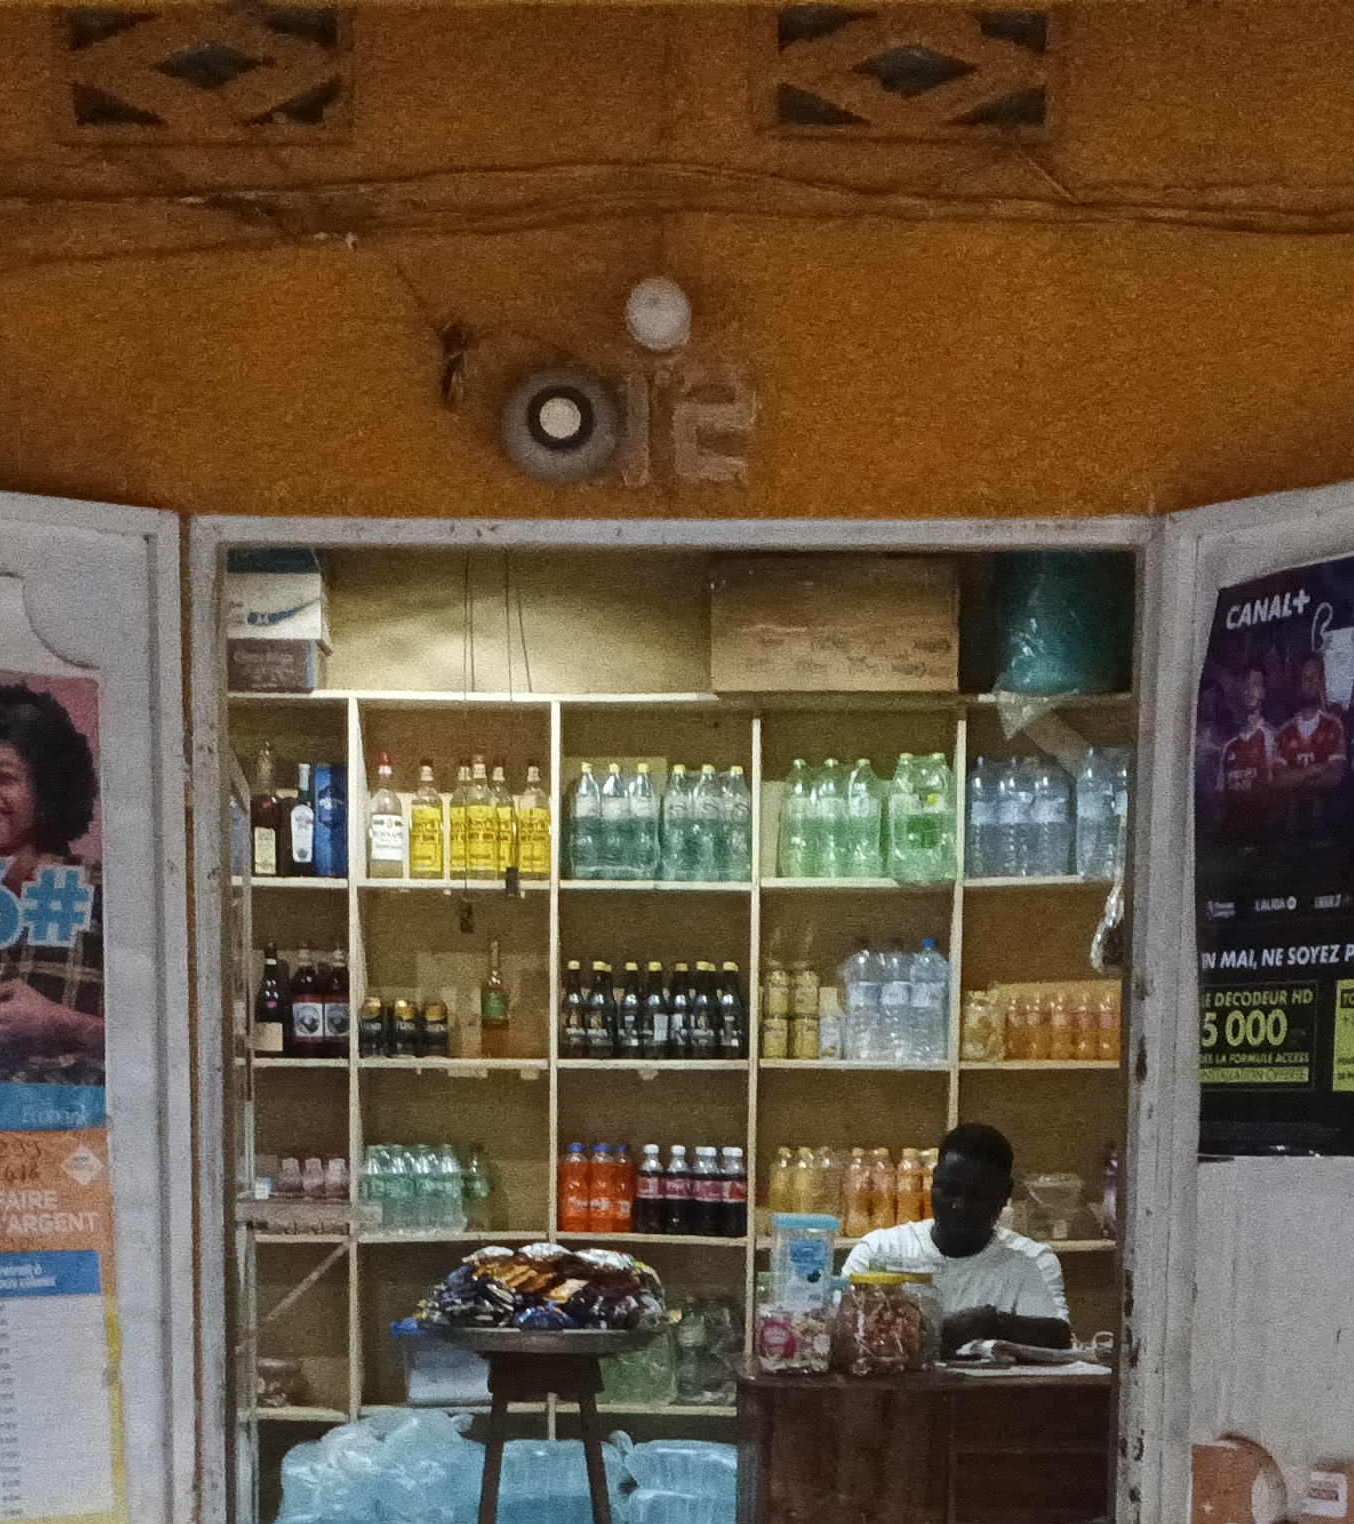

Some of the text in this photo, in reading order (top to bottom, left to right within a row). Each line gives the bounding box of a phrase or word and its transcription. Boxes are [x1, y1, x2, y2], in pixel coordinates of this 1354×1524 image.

[1225, 588, 1310, 631] CANAL+
[1262, 947, 1283, 967] NE
[1288, 944, 1340, 966] SOYEZ
[1292, 988, 1314, 1004] HD
